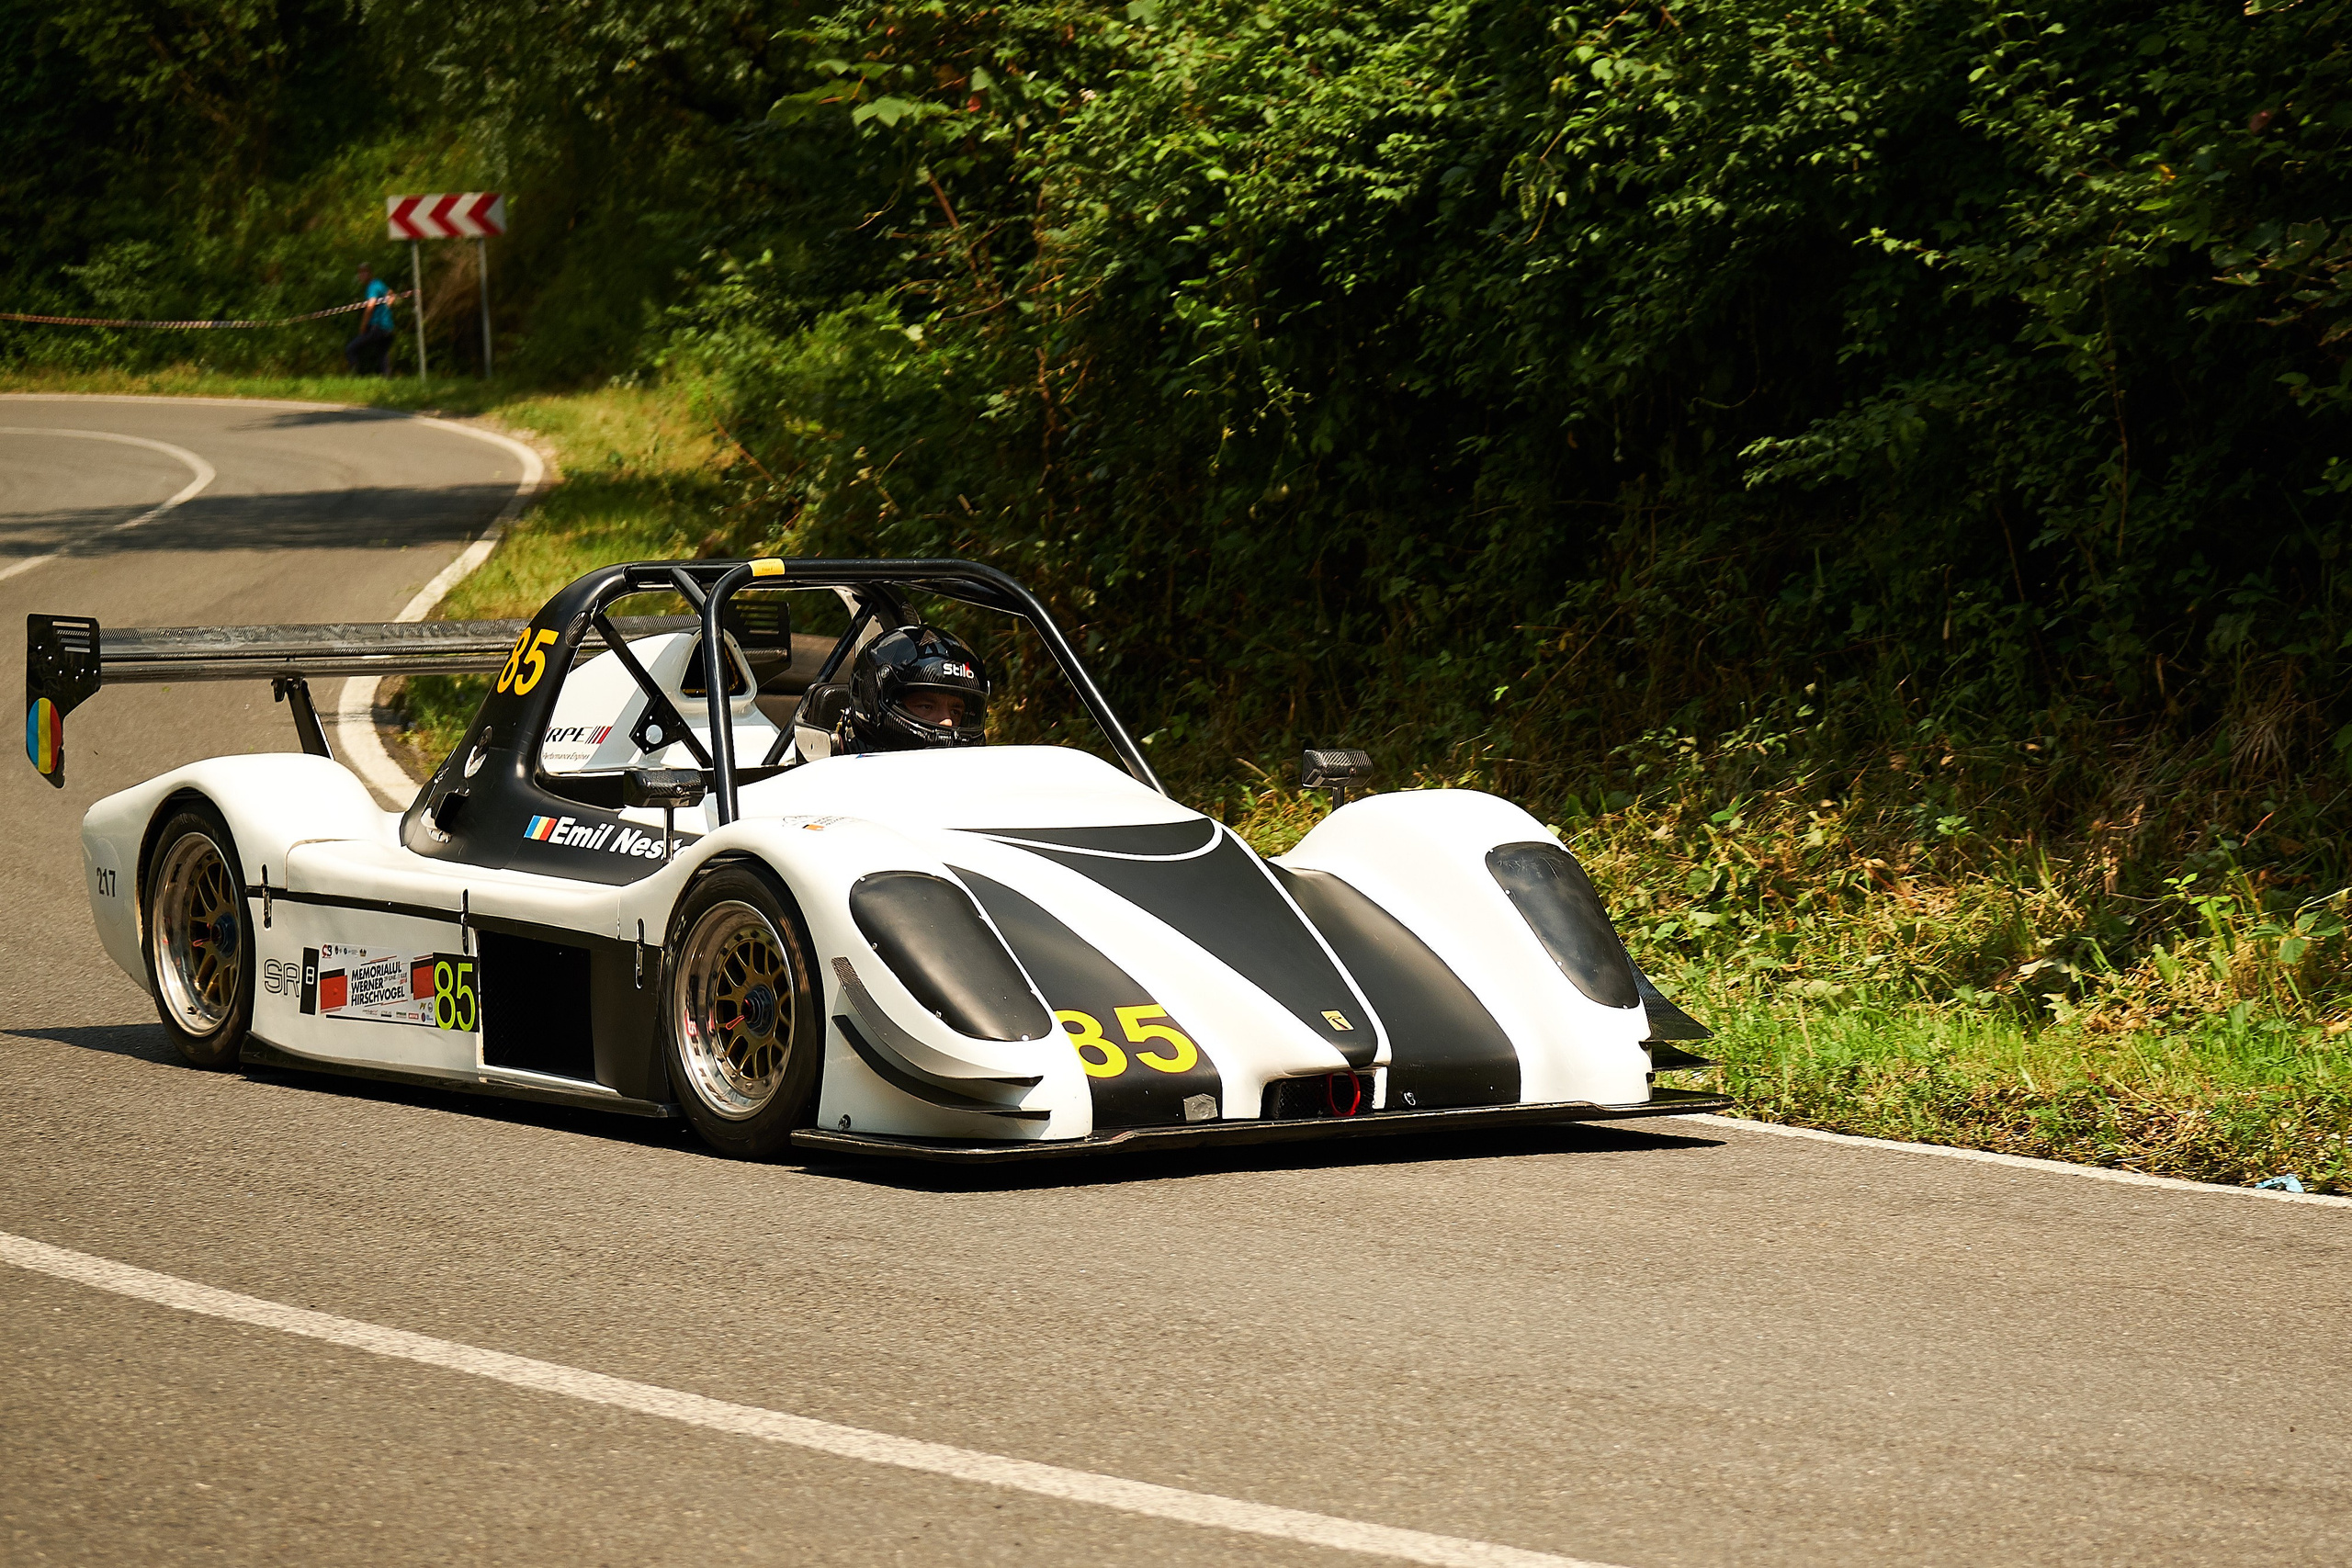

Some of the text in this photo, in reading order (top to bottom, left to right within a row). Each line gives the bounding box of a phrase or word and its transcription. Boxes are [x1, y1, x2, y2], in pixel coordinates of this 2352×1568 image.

[497, 626, 560, 696] 85
[943, 662, 975, 679] Stilo
[548, 817, 616, 851] Emil
[96, 867, 116, 897] 217
[351, 961, 402, 981] MEMORIALUL
[351, 976, 384, 994] WERNER
[351, 986, 405, 1007] HIRSCHVOGEL
[434, 961, 475, 1032] 85
[1054, 1004, 1198, 1078] 85
